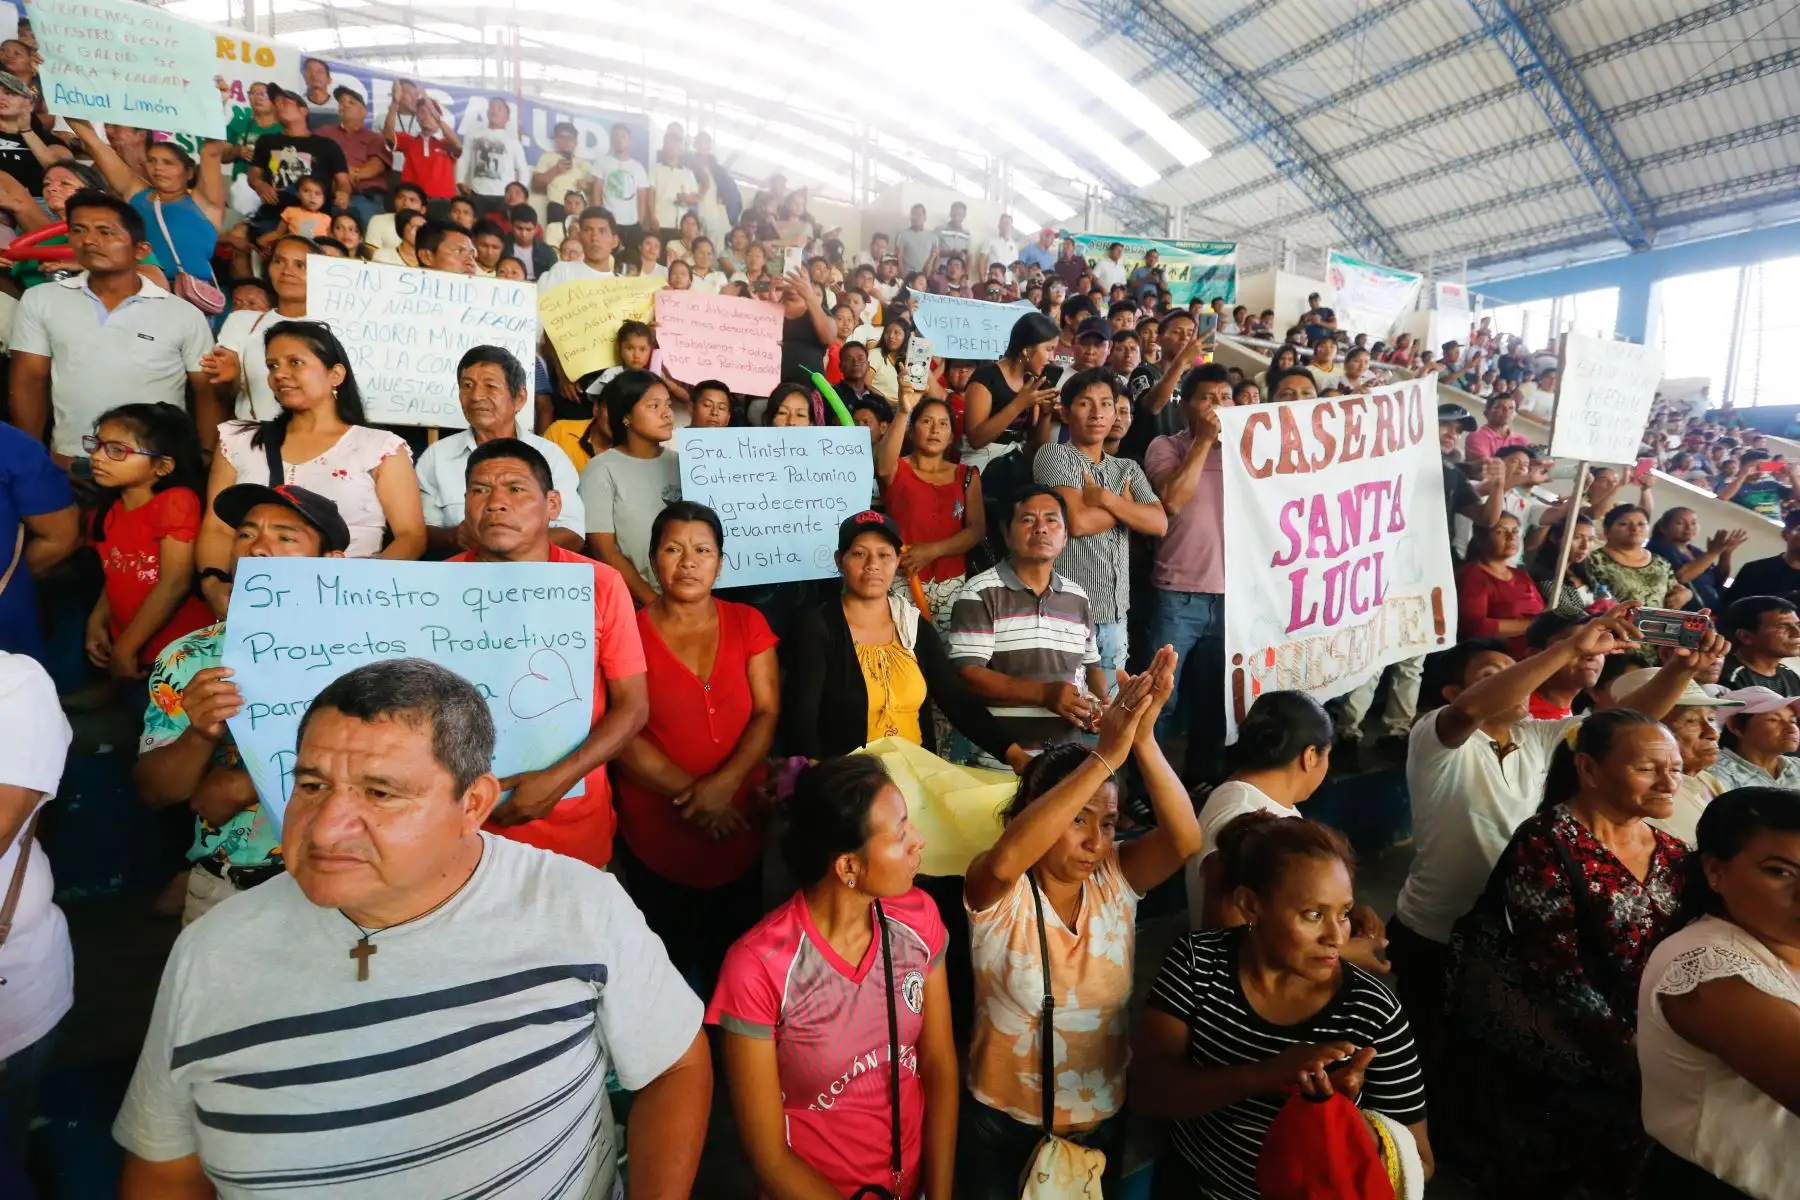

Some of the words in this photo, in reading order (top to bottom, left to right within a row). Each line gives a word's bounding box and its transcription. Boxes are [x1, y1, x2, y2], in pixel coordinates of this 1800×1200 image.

[123, 93, 178, 116] Limón
[324, 264, 383, 292] SIN
[396, 271, 479, 305] SALUD
[324, 290, 372, 318] HAY
[382, 298, 444, 317] NADA
[922, 315, 970, 330] VISITA
[350, 344, 376, 371] OR
[384, 350, 410, 372] LA
[367, 374, 449, 396] NUESTRO
[387, 395, 458, 416] SALUD
[1240, 383, 1425, 480] CASERIO
[685, 438, 732, 460] Sra.
[737, 436, 809, 459] Ministra
[817, 438, 864, 456] Rosa
[690, 464, 778, 486] Gutierrez
[783, 465, 857, 484] Palomino
[707, 493, 848, 522] Agradecemos
[1270, 473, 1407, 568] SANTA
[722, 515, 824, 538] uevamente
[722, 545, 802, 571] Visita
[244, 573, 300, 609] Sr.
[316, 573, 440, 609] Ministro
[462, 583, 592, 622] queremos
[242, 631, 407, 672] Proyectos
[420, 623, 587, 655] Productivos
